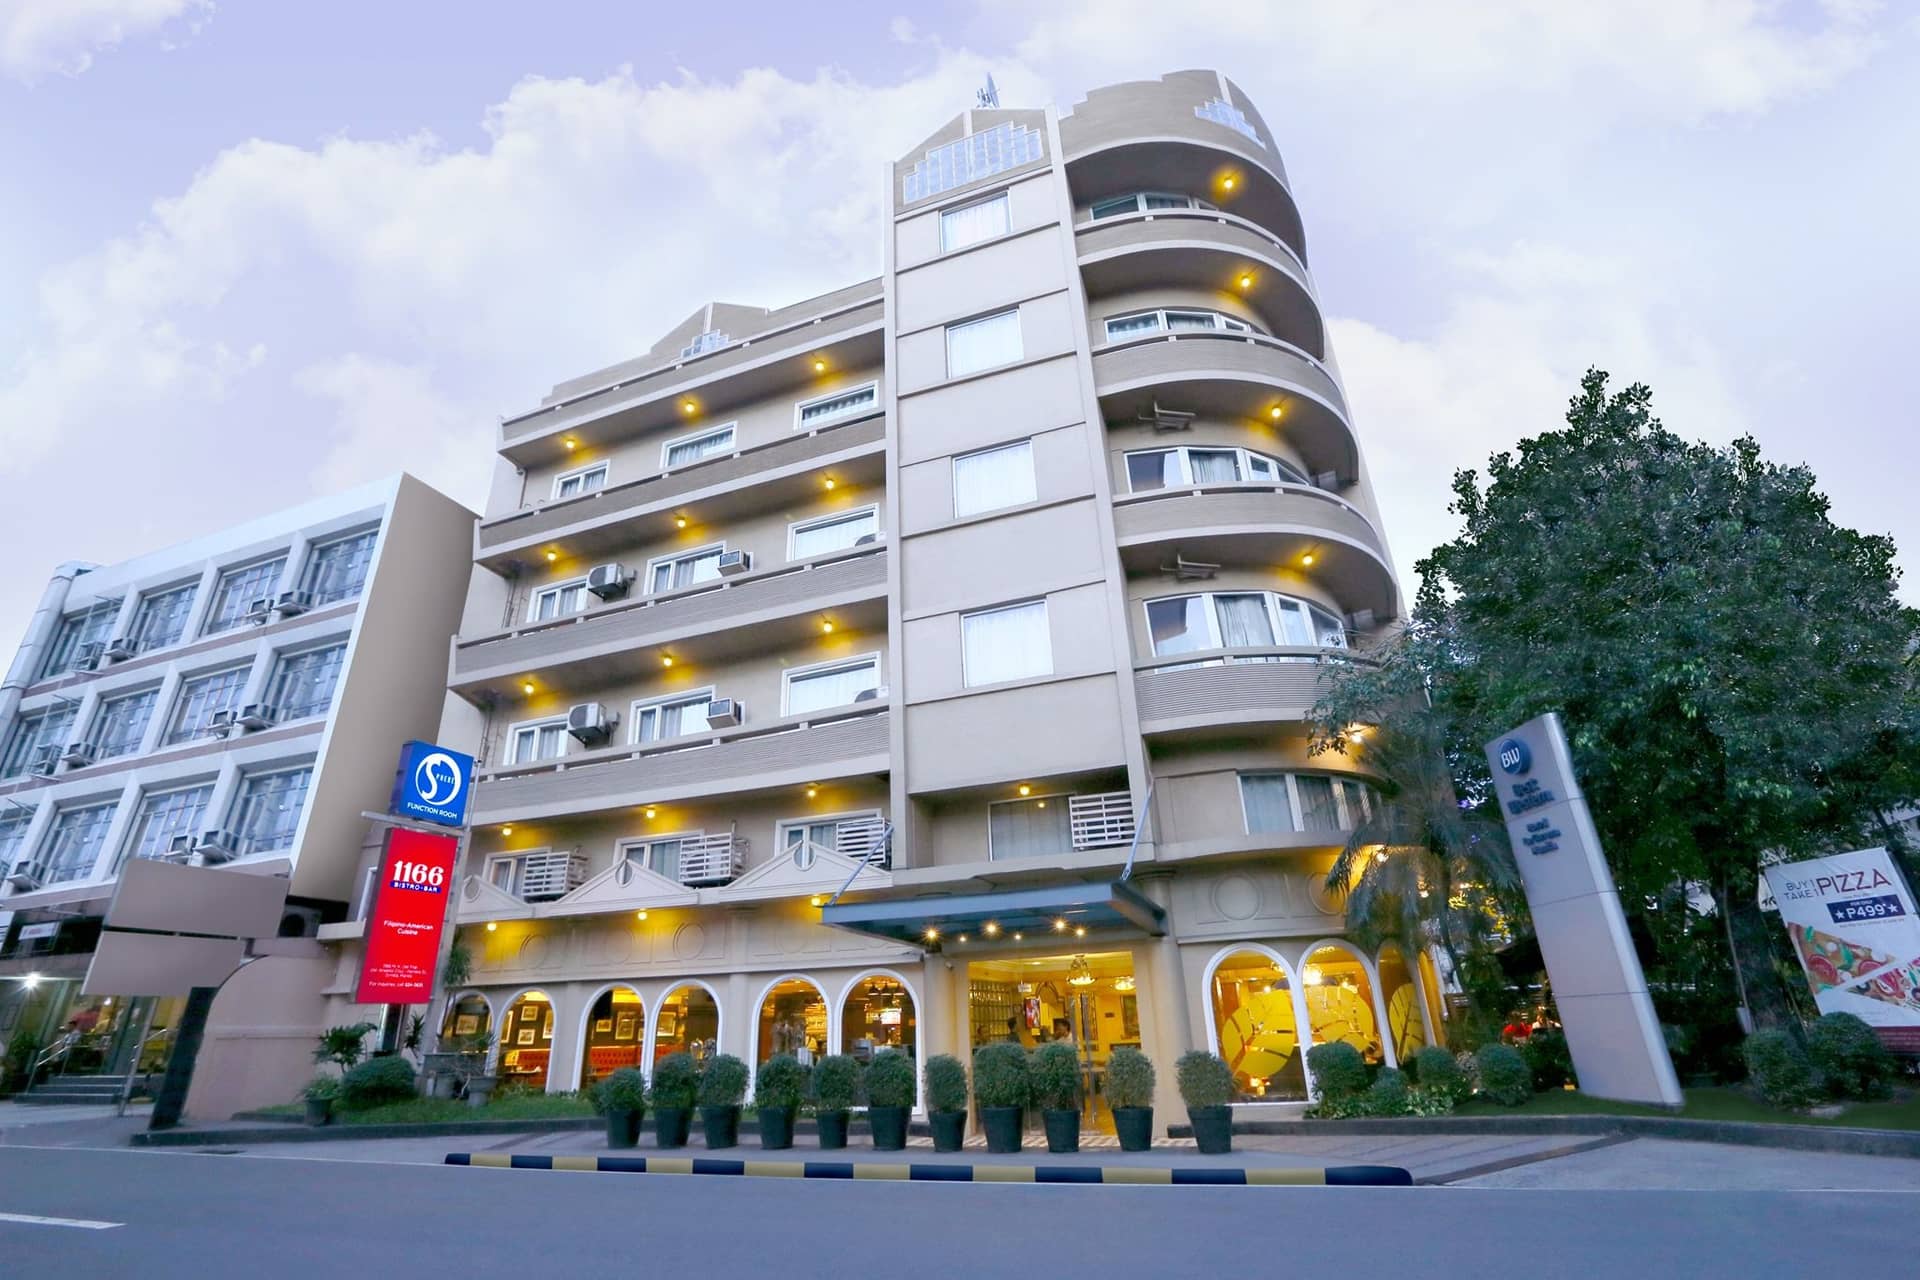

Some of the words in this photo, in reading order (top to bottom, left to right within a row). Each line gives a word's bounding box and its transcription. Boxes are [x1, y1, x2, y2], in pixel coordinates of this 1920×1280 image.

[1501, 747, 1520, 768] BW
[407, 802, 438, 815] FUNCTION
[439, 810, 457, 820] ROOM
[393, 861, 444, 886] 1166
[1816, 868, 1892, 895] PIZZA
[1786, 880, 1808, 891] BUY
[1784, 890, 1812, 901] TAKE
